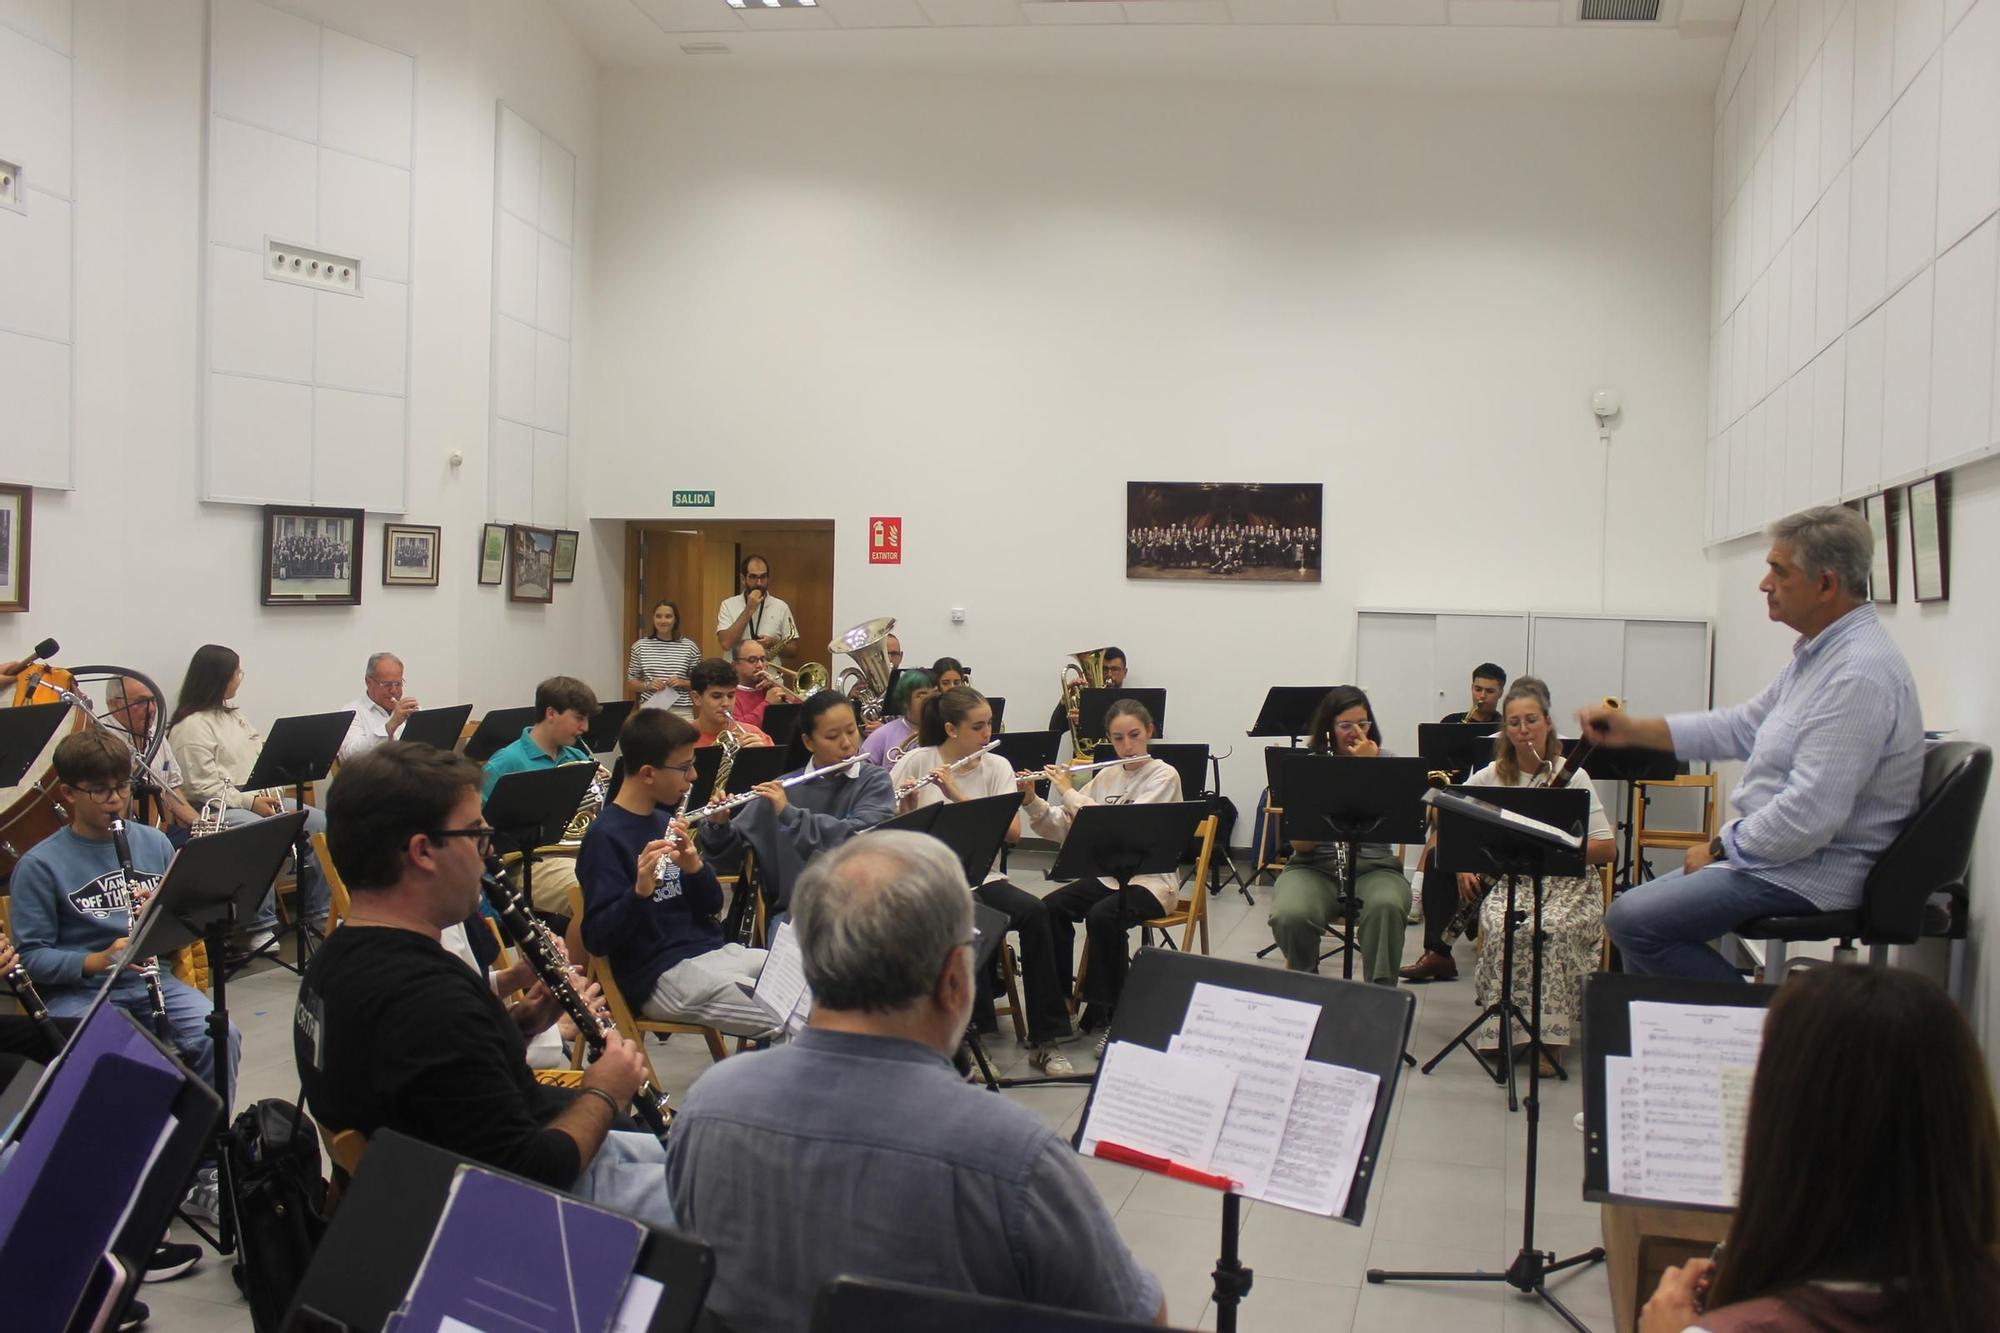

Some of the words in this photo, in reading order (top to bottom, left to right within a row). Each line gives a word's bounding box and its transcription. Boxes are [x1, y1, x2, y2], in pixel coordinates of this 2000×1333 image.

[675, 493, 711, 504] SALIDA
[871, 551, 898, 560] EXTINTOR
[96, 874, 125, 892] VAN
[103, 888, 126, 907] TH
